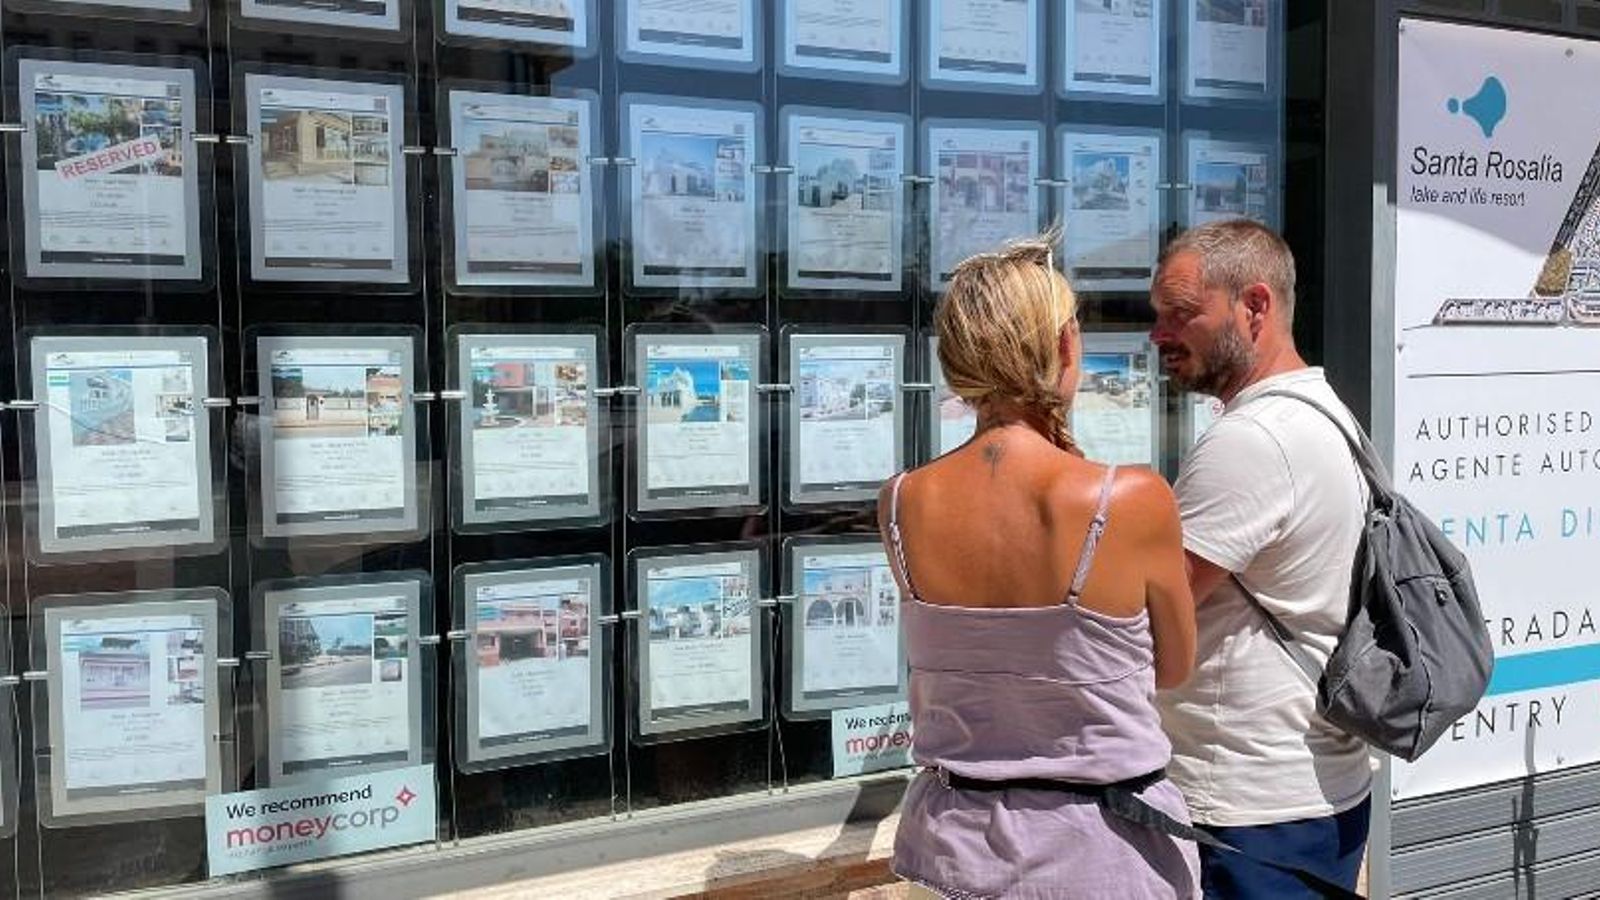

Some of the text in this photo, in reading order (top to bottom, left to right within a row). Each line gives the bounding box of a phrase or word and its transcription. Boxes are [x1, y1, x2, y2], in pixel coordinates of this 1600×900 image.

[59, 141, 157, 179] RESERVED
[1411, 146, 1478, 177] Santa
[1410, 185, 1526, 207] lake and life resort
[1416, 411, 1593, 441] AUTHORISED
[1409, 453, 1522, 482] AGENTE
[1441, 506, 1593, 547] ENTA DI
[1484, 607, 1596, 646] RADA
[845, 717, 867, 730] We
[1451, 694, 1567, 742] ENTRY
[845, 731, 912, 754] money
[226, 785, 373, 820] We recommend
[227, 805, 400, 849] moneycorp
